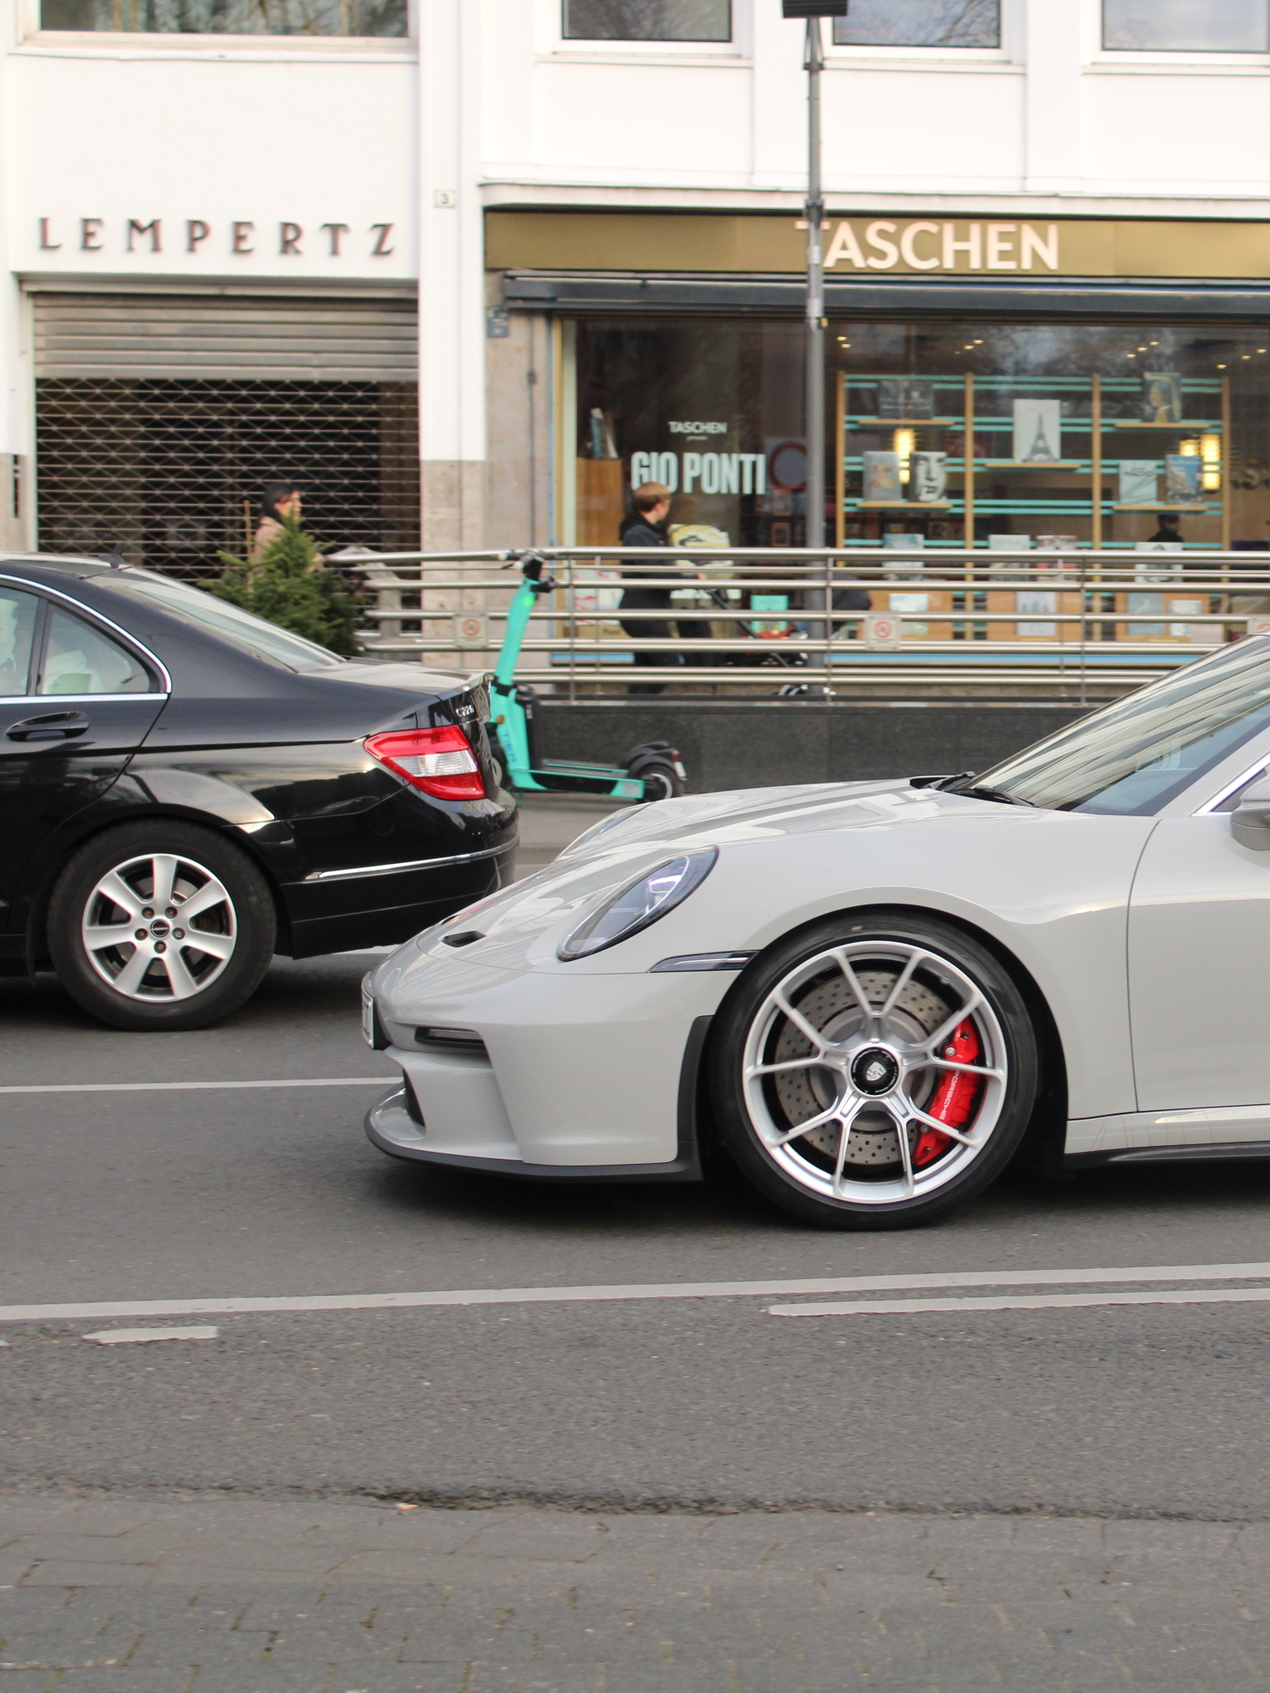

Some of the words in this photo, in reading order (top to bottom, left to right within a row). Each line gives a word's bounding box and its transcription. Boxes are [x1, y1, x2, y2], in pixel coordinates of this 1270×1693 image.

[440, 193, 449, 204] 3
[38, 217, 397, 256] LEMPERTZ
[668, 421, 728, 434] TASCHEN
[631, 451, 679, 494] GIO
[682, 452, 766, 495] PONTI
